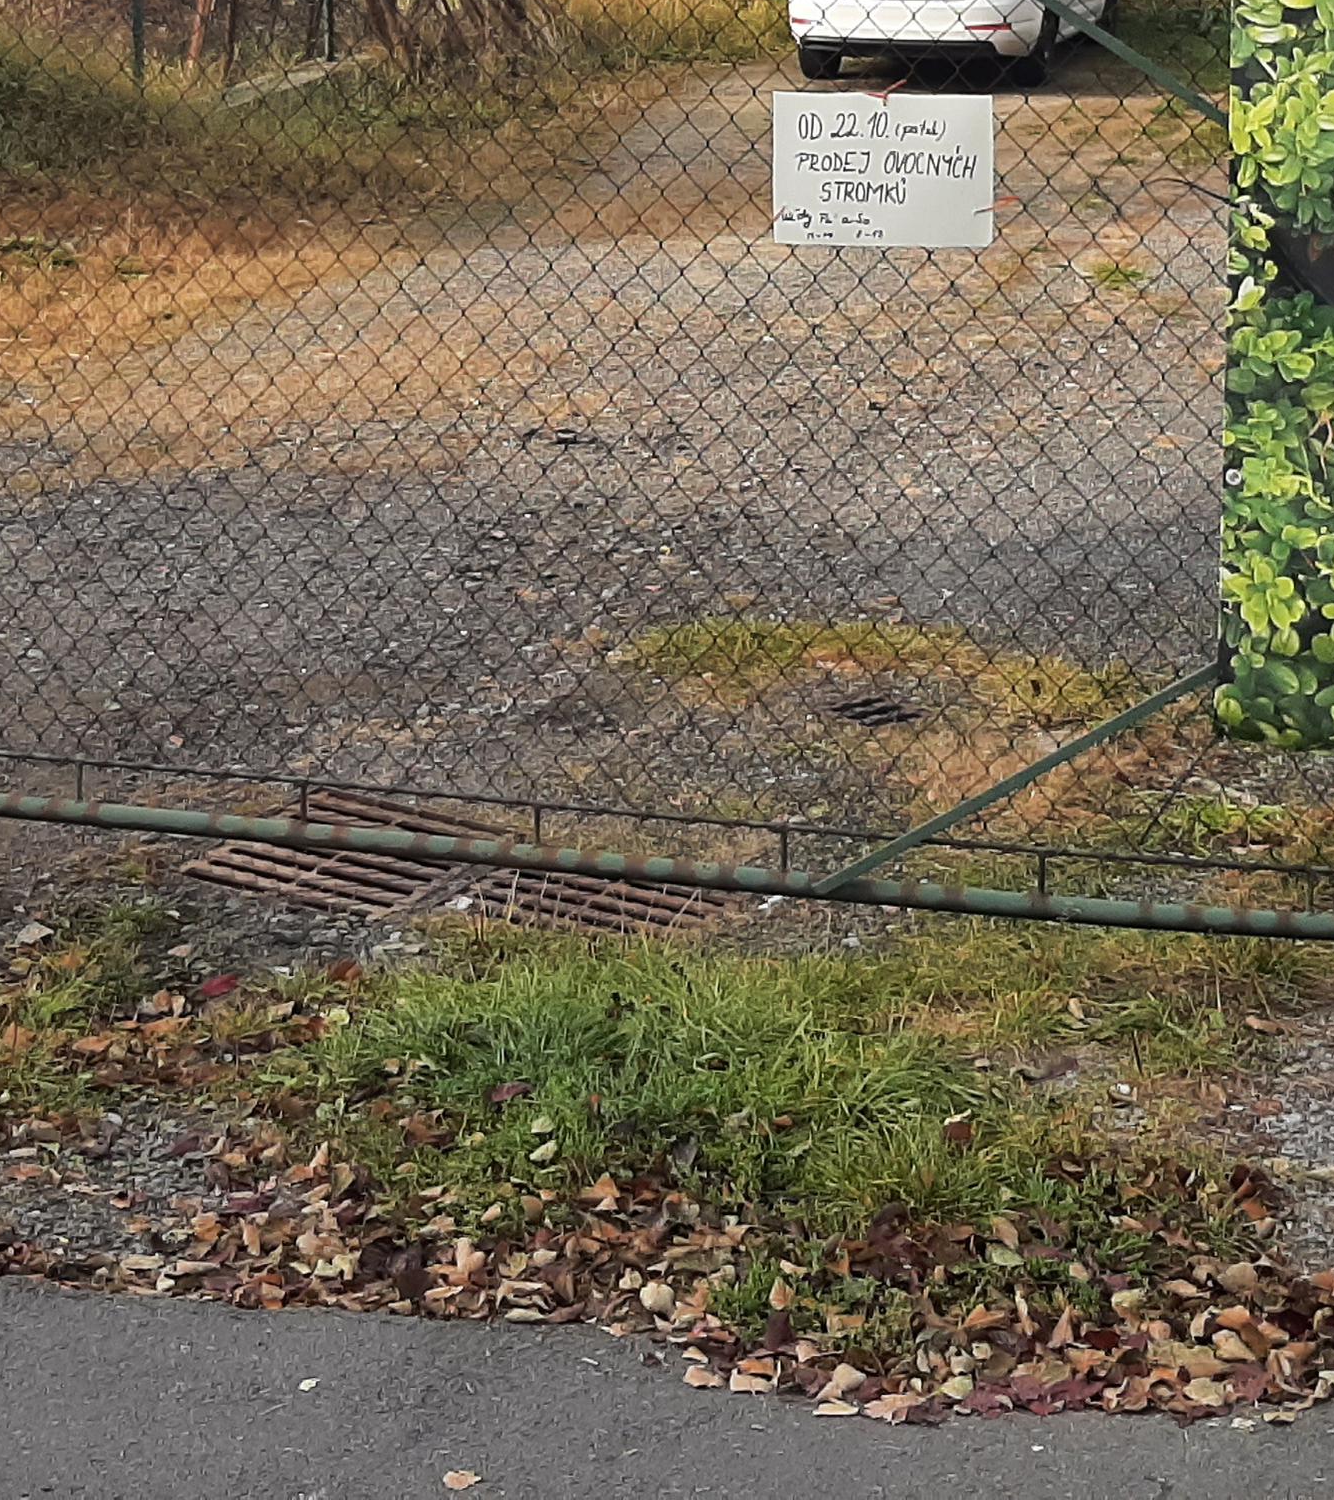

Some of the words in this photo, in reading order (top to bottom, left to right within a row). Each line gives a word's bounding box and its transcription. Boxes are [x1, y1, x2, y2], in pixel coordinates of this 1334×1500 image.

[798, 112, 822, 140] OD
[795, 151, 871, 174] PRODEJ
[884, 145, 977, 180] OVOCNÝCH
[819, 177, 907, 204] STROMKŮ
